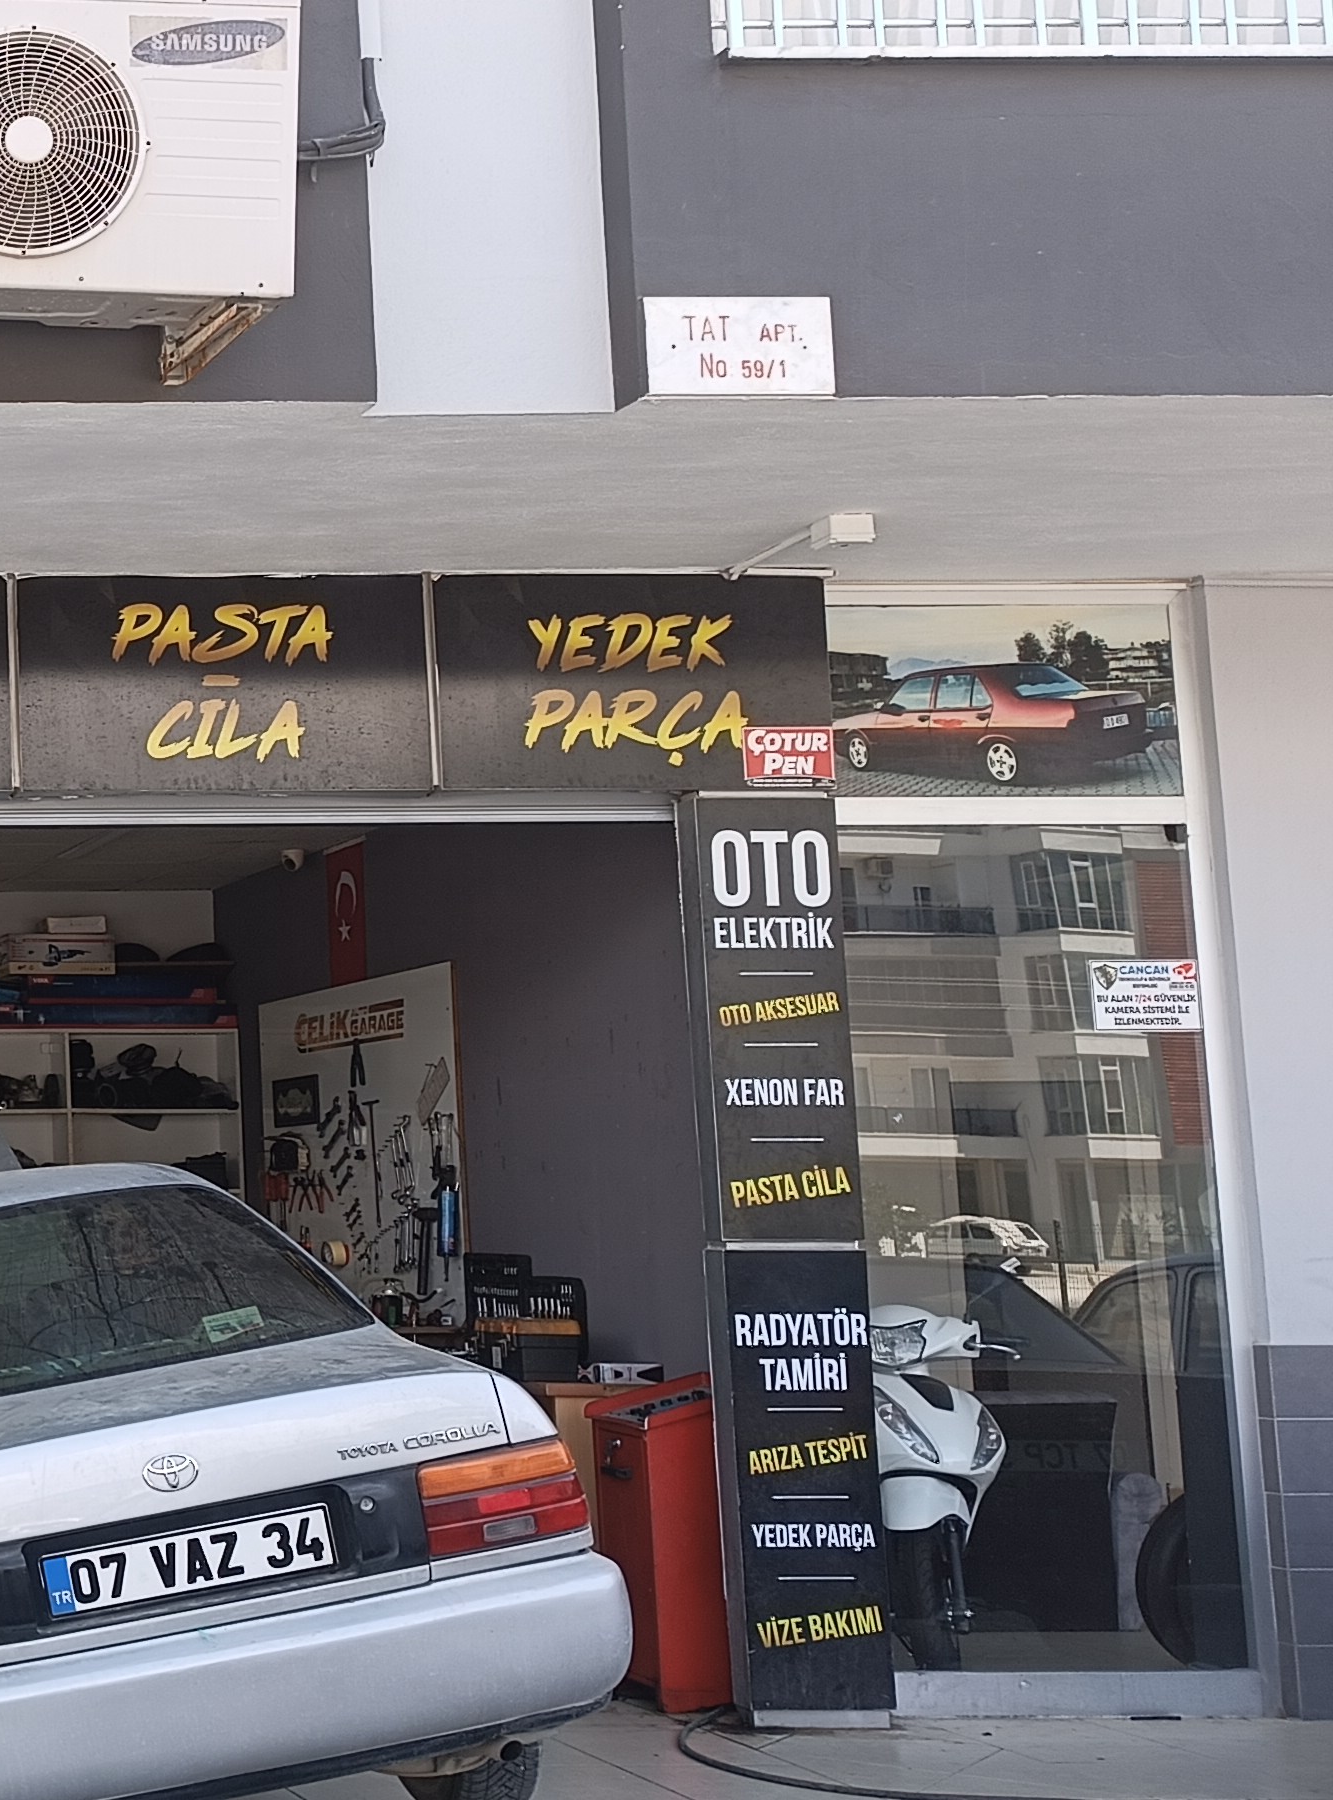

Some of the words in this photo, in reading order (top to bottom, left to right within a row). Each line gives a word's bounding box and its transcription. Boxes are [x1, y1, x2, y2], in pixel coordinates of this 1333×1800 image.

[150, 33, 269, 52] SAMSUNG
[681, 315, 731, 342] TAT
[759, 323, 804, 343] APT.
[741, 359, 787, 379] 59/1
[110, 602, 334, 668] PASTA
[527, 612, 734, 673] YEDEK
[524, 688, 750, 768] PARÇA
[747, 729, 829, 757] ÇOTUR
[763, 752, 815, 775] PEN
[710, 829, 832, 908] OTO
[712, 911, 835, 950] ELEKTRİK
[1119, 965, 1169, 975] CANCAN
[718, 1003, 752, 1027] OTO
[755, 991, 840, 1022] AKSESUAR
[1096, 994, 1109, 1003] BU
[1110, 994, 1133, 1003] ALAN
[1134, 993, 1152, 1004] 7/24
[1153, 992, 1197, 1003] GÜVENLİK
[1104, 1005, 1141, 1014] KAMERA
[723, 1077, 800, 1107] XENON
[803, 1077, 845, 1106] FAR
[730, 1173, 800, 1209] PASTA
[801, 1163, 852, 1198] CİLA
[734, 1307, 868, 1348] RADYATÖR
[759, 1351, 849, 1392] TAMİRİ
[336, 1440, 399, 1461] TOYOTA
[402, 1421, 502, 1451] COROLLA
[748, 1444, 805, 1476] ARIZA
[804, 1431, 869, 1467] TESPİT
[751, 1523, 812, 1548] YEDEK
[815, 1523, 876, 1552] PARÇA
[52, 1589, 73, 1607] TR
[69, 1550, 128, 1605] 07
[149, 1532, 246, 1596] VAZ
[266, 1516, 326, 1568] 34
[756, 1614, 806, 1649] VİZE
[807, 1604, 884, 1644] BAKIMI
